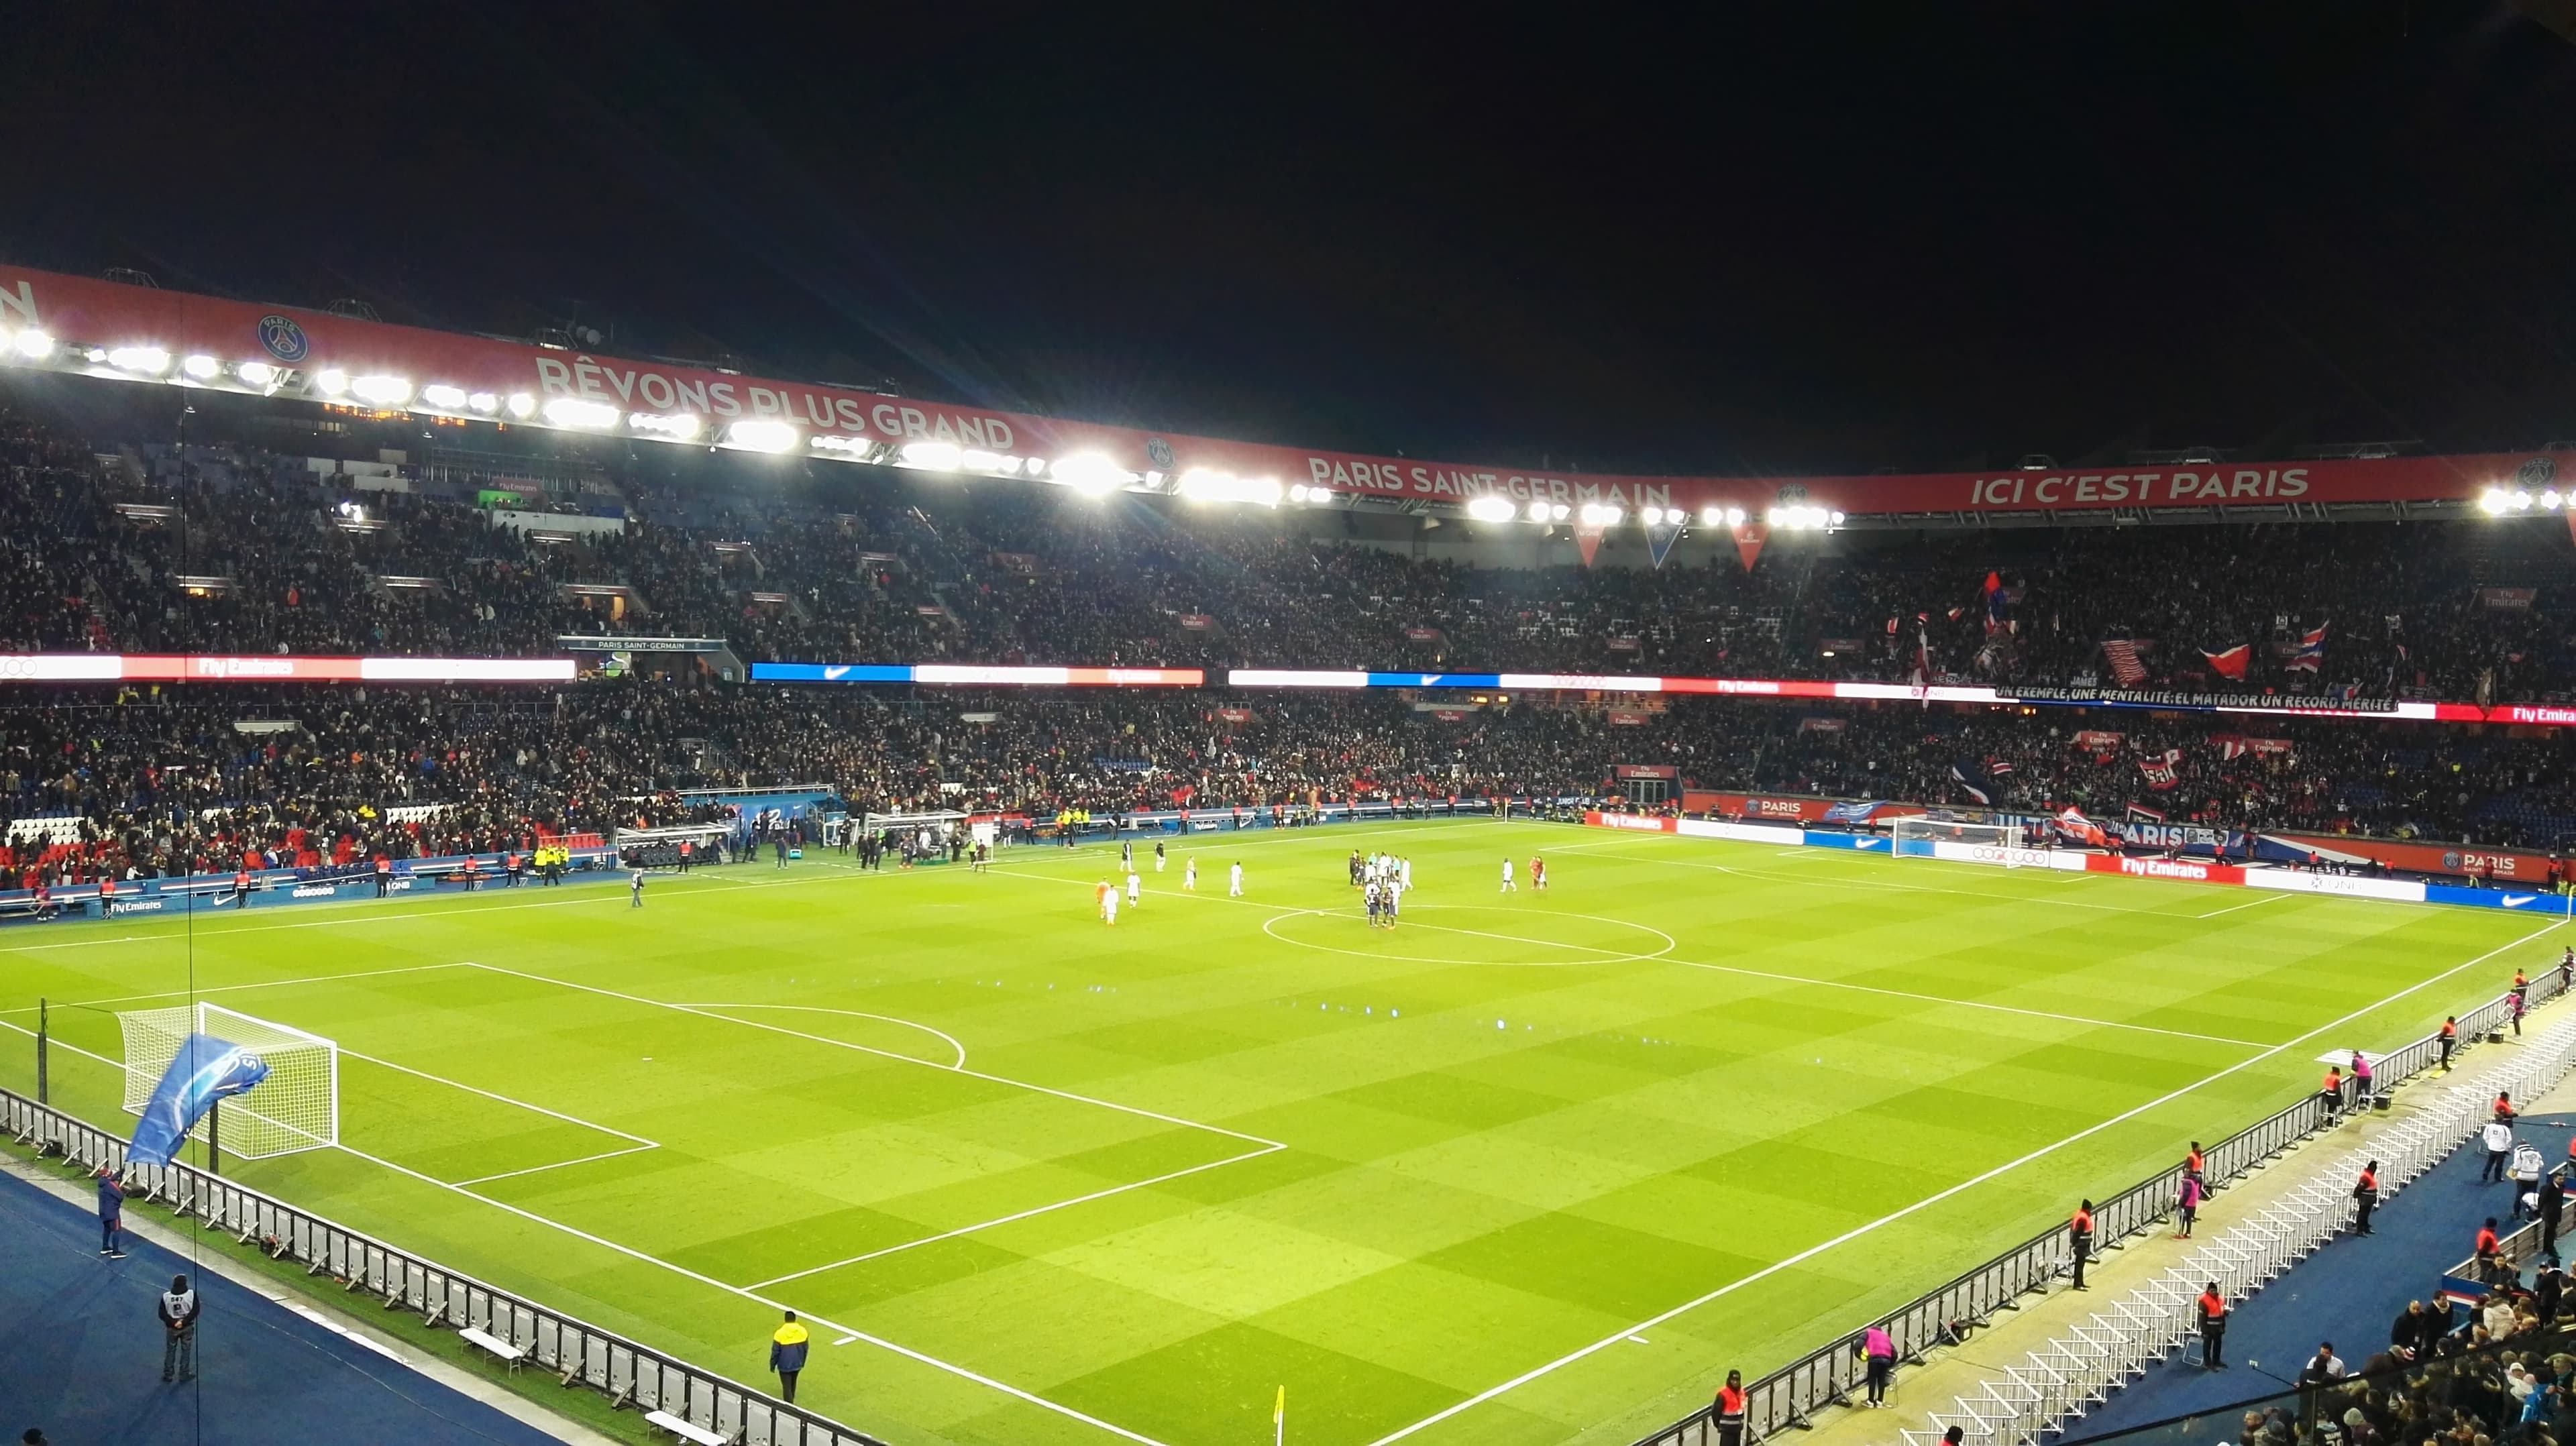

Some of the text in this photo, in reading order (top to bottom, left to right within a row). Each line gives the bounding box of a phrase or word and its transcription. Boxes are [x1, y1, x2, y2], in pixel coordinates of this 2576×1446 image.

[536, 355, 1014, 449] RÊVONS PLUS GRAND
[511, 484, 537, 492] Emirates
[1309, 457, 1670, 507] PARIS SAINT-GERMAIN
[1972, 469, 2308, 504] ICI C'EST PARIS
[2485, 597, 2528, 606] Emirates
[199, 658, 294, 677] Fly Emirates
[1717, 680, 1736, 693] Fly
[2070, 676, 2098, 687] JAMES
[1996, 686, 2013, 697] UN
[2072, 689, 2097, 700] UNE
[2193, 693, 2258, 706] MATADOR
[2261, 695, 2282, 708] UN
[2285, 696, 2339, 709] RECORD
[2513, 708, 2535, 723] Fly
[1762, 801, 1801, 813] PARIS
[1601, 813, 1662, 830] Fly Emirates
[2123, 824, 2182, 847] ARIS
[2122, 858, 2207, 879] Fly Emirates
[2464, 854, 2515, 870] PARIS
[391, 881, 411, 891] QNB
[111, 901, 162, 913] Fly Emirates
